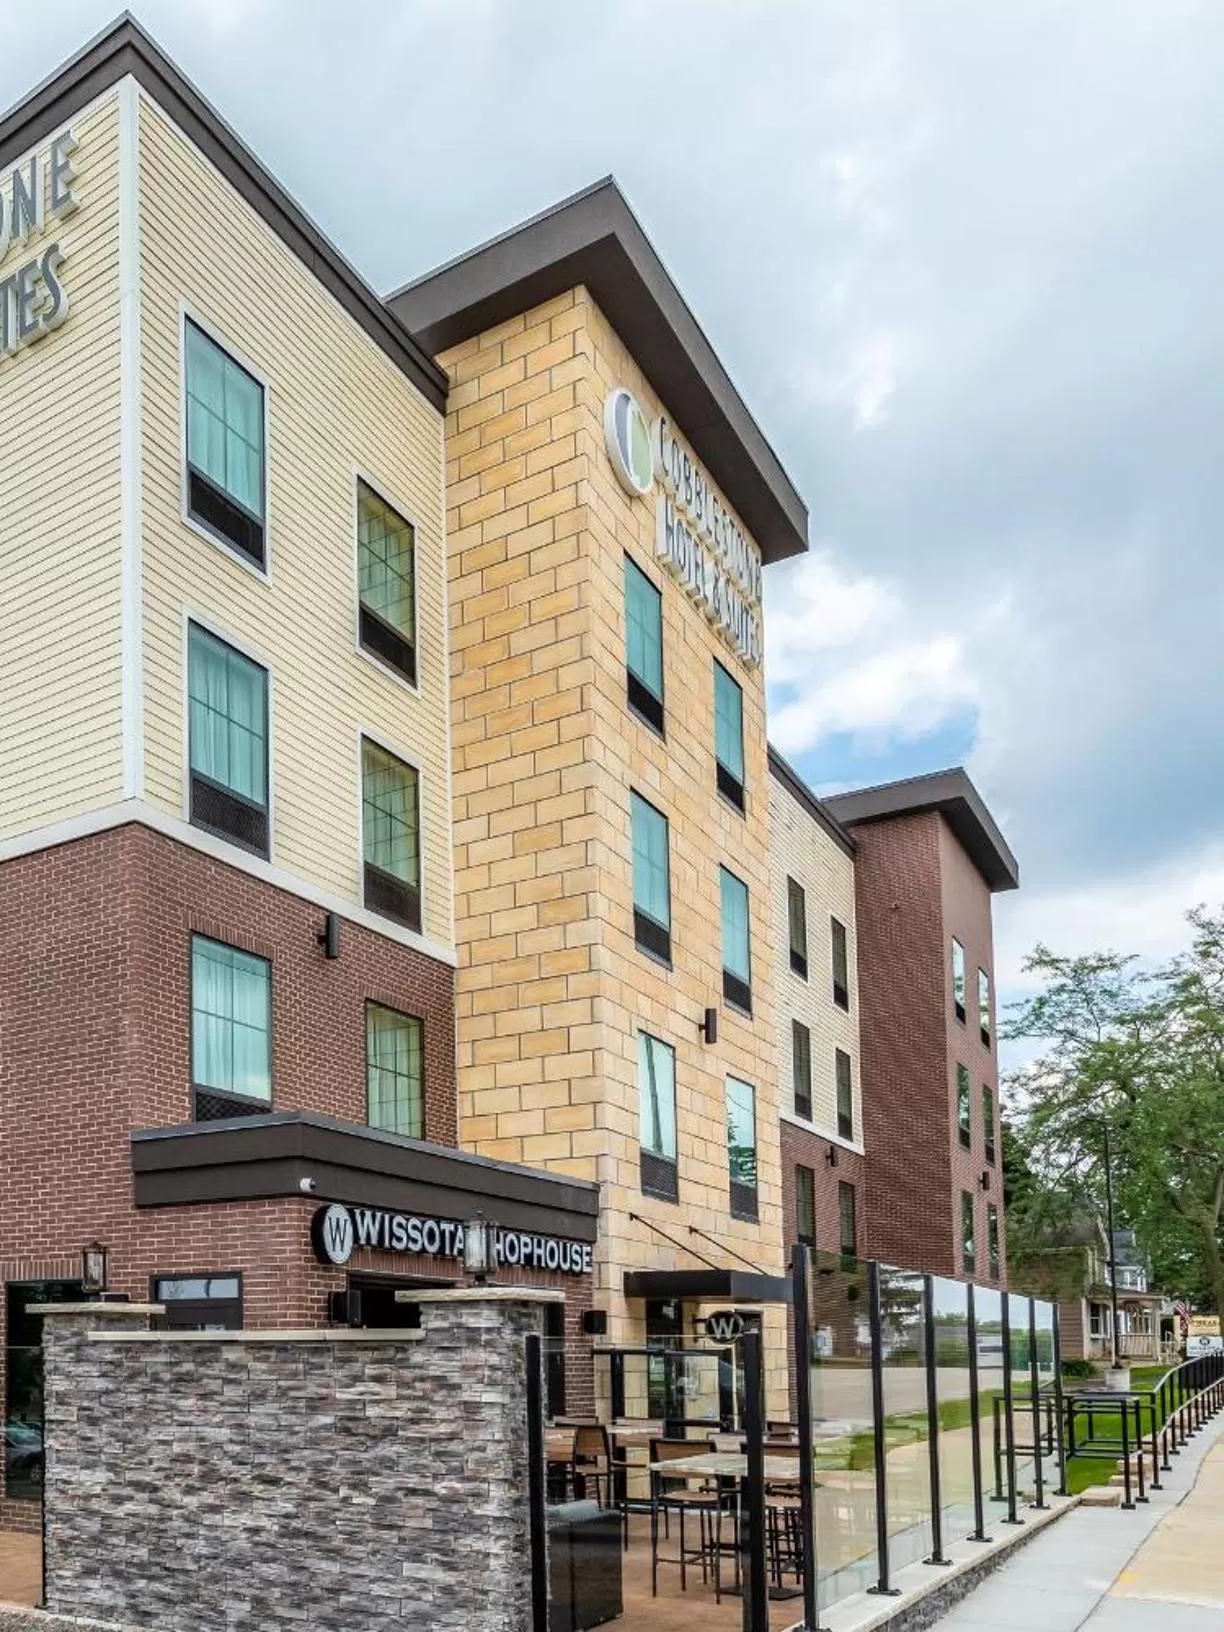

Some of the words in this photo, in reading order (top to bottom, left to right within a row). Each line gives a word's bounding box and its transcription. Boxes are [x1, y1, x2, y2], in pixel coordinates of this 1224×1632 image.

[354, 1208, 464, 1256] WISSOTA
[494, 1230, 592, 1273] HOPHOUSE
[708, 1316, 736, 1339] W
